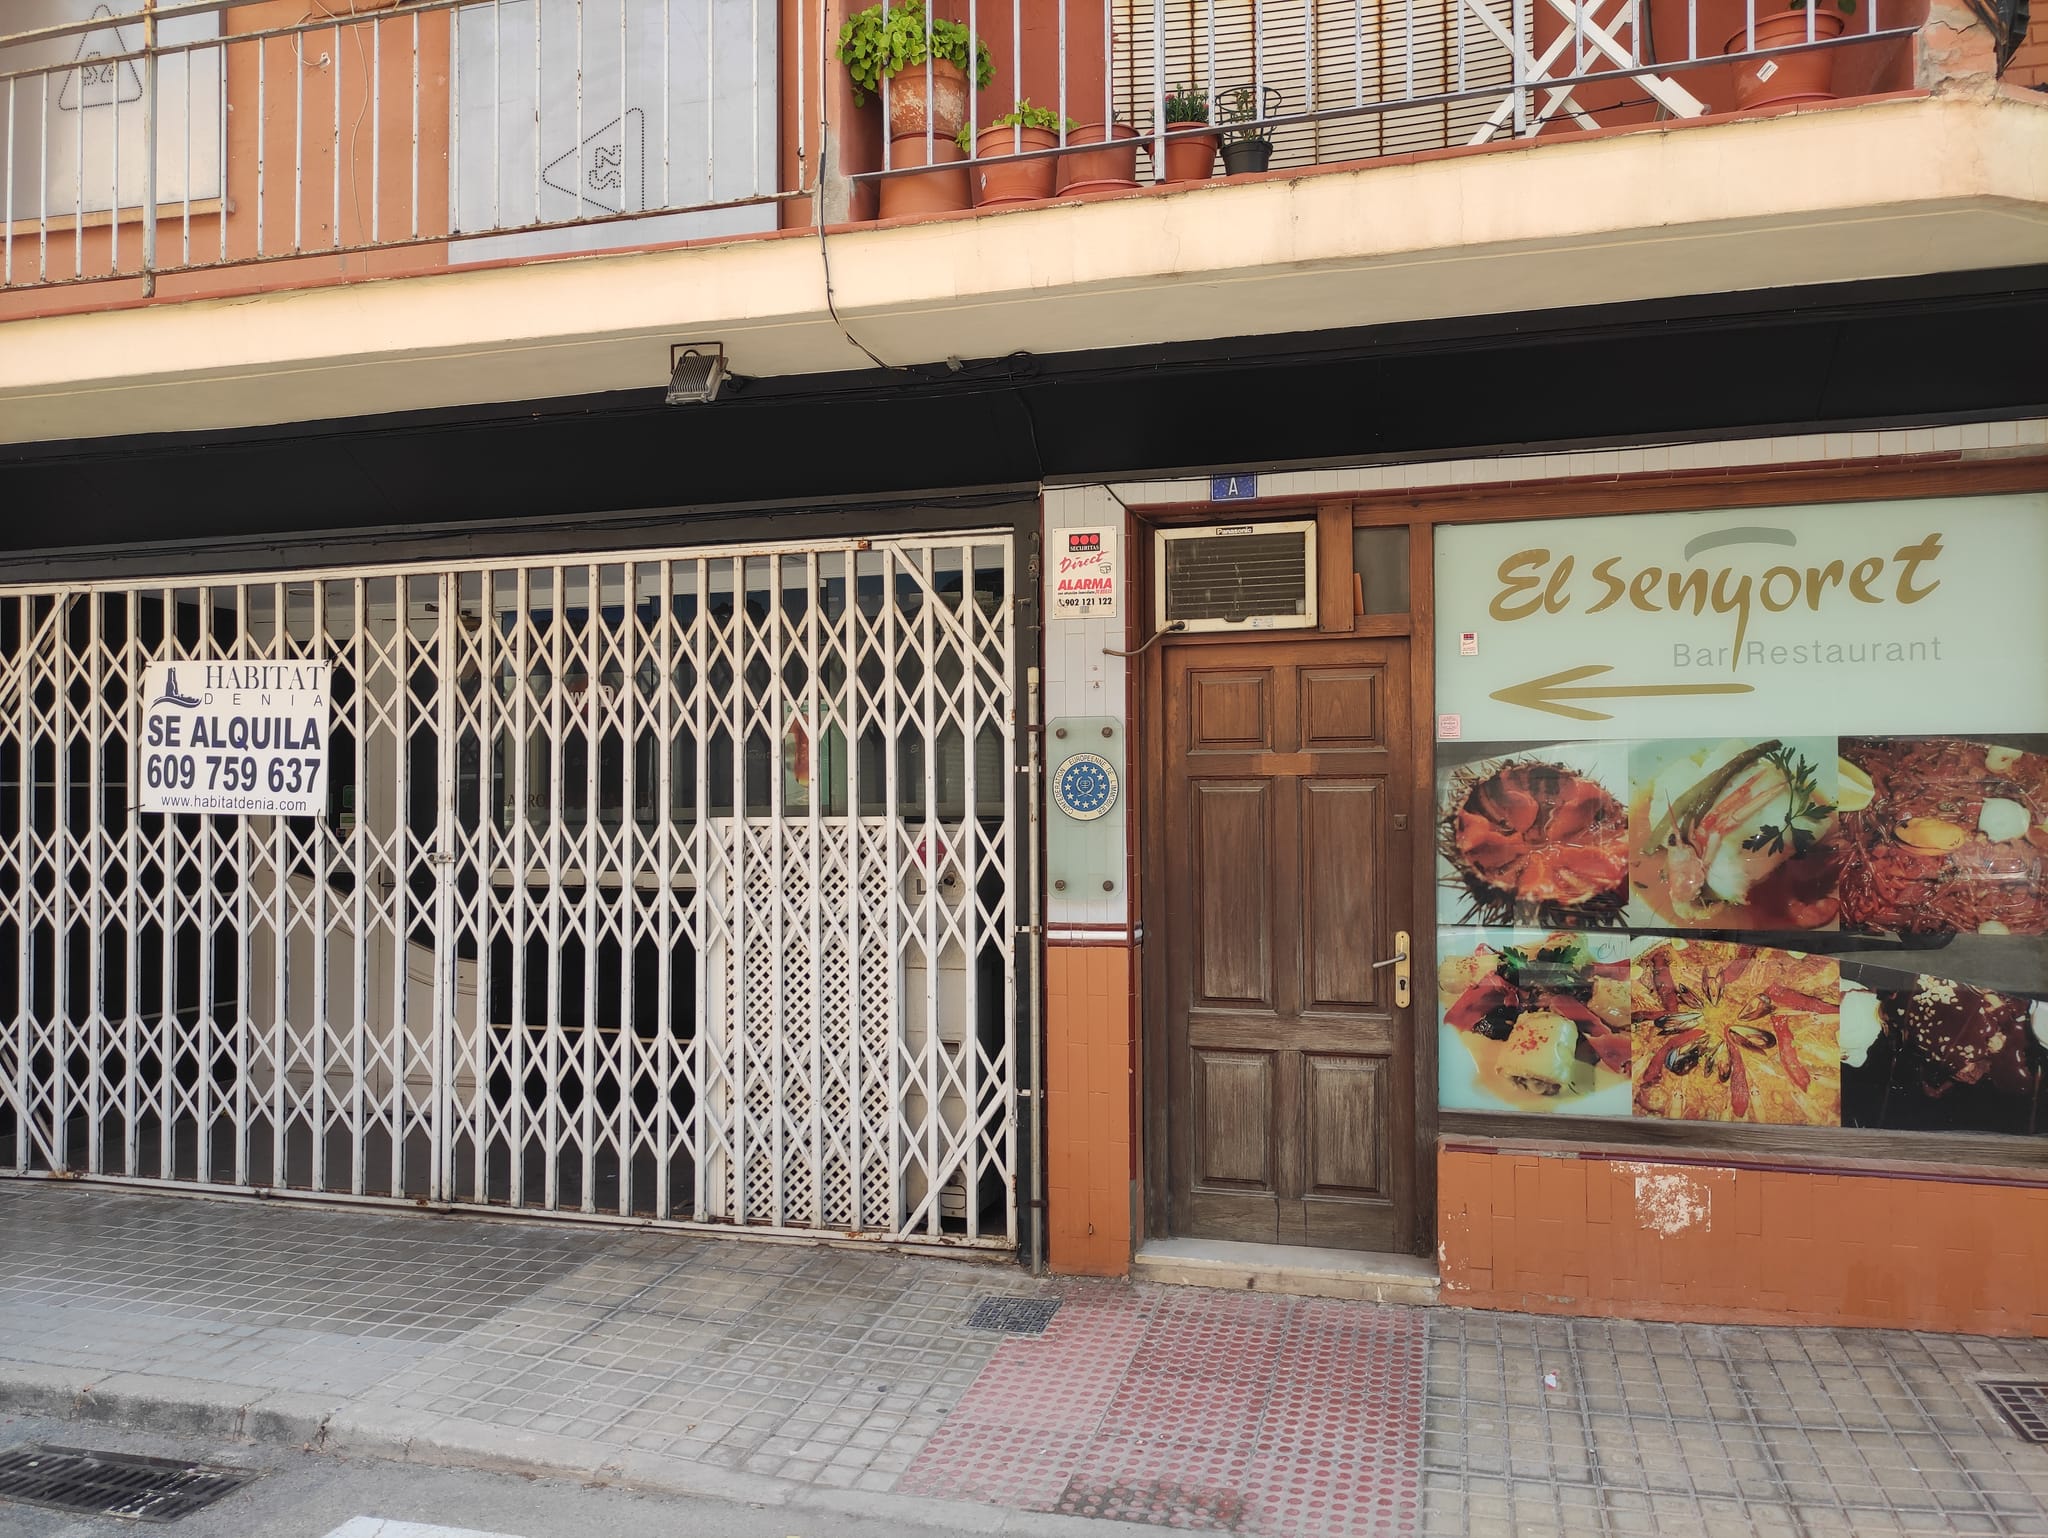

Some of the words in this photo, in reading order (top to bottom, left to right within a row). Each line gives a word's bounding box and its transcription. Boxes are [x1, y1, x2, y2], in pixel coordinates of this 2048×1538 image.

[1228, 477, 1239, 496] A
[1216, 527, 1253, 535] Panasonic
[1060, 551, 1109, 573] Direct
[1058, 577, 1112, 590] ALARMA
[1488, 548, 1575, 622] El
[1065, 598, 1079, 606] 902
[1673, 643, 1728, 667] Bar
[1747, 636, 1942, 665] Restaurant
[206, 665, 325, 690] HABITAT
[204, 693, 323, 707] DENIA
[148, 715, 181, 747] SE
[190, 715, 321, 751] ALQUILA
[147, 753, 195, 789] 609
[206, 755, 257, 791] 759
[268, 757, 321, 793] 637
[161, 795, 307, 811] www.habitatdenia.com
